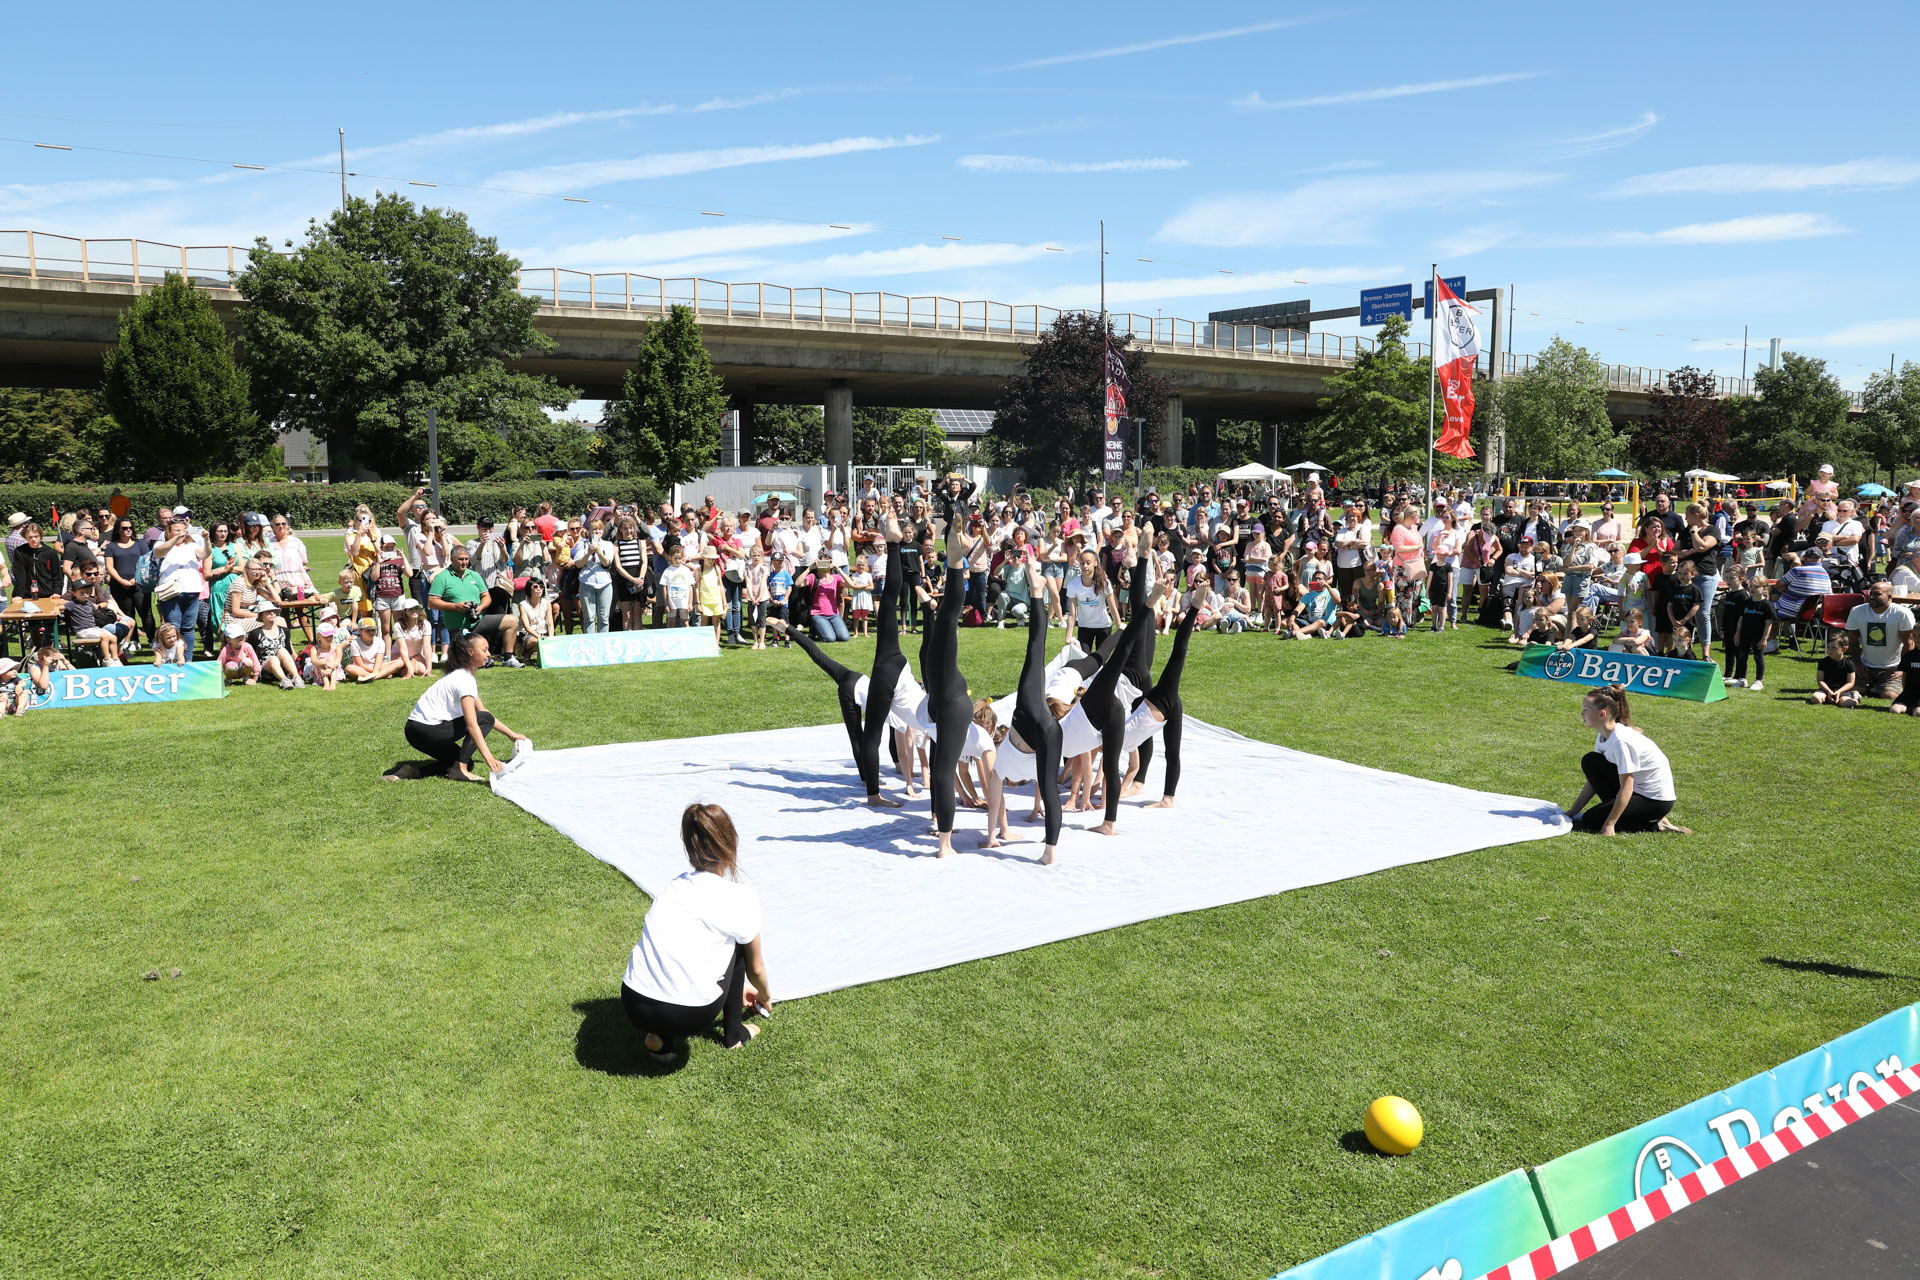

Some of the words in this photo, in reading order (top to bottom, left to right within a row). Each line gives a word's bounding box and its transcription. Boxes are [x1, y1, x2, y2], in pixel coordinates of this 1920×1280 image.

[1363, 295, 1383, 303] Bremen
[1384, 291, 1409, 300] Dortmund
[1371, 301, 1401, 310] Oberhausen
[602, 635, 689, 661] Bayer
[1548, 660, 1572, 669] BAYER
[1577, 653, 1681, 689] Bayer
[62, 672, 186, 702] Bayer
